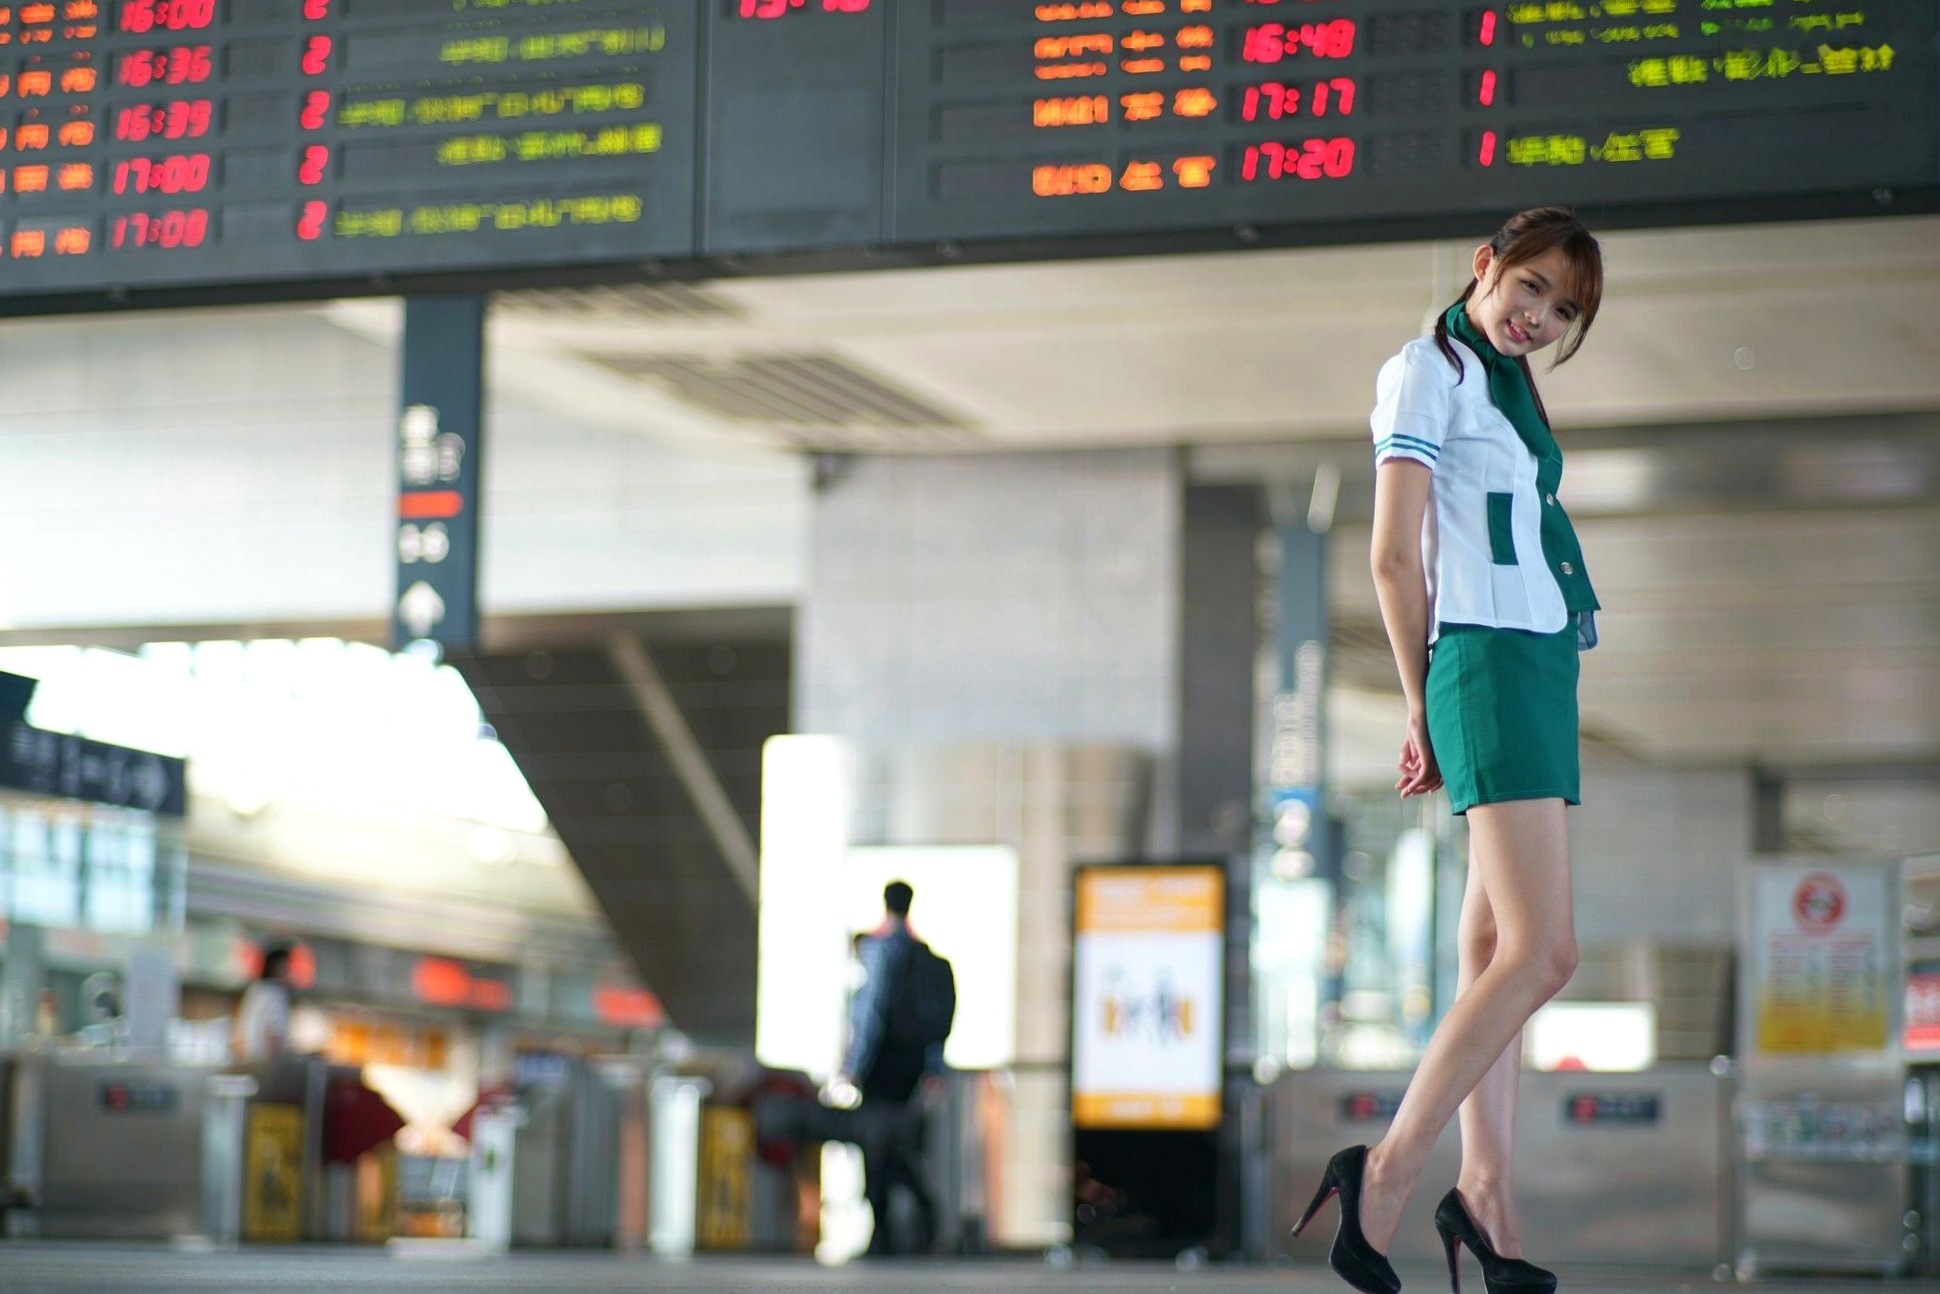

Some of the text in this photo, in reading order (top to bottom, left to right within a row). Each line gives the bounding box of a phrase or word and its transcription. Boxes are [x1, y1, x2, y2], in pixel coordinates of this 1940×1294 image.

[1242, 18, 1356, 64] 16:48
[1242, 77, 1356, 122] 17:17
[113, 153, 211, 195] 17:00
[1241, 137, 1355, 181] 17:20
